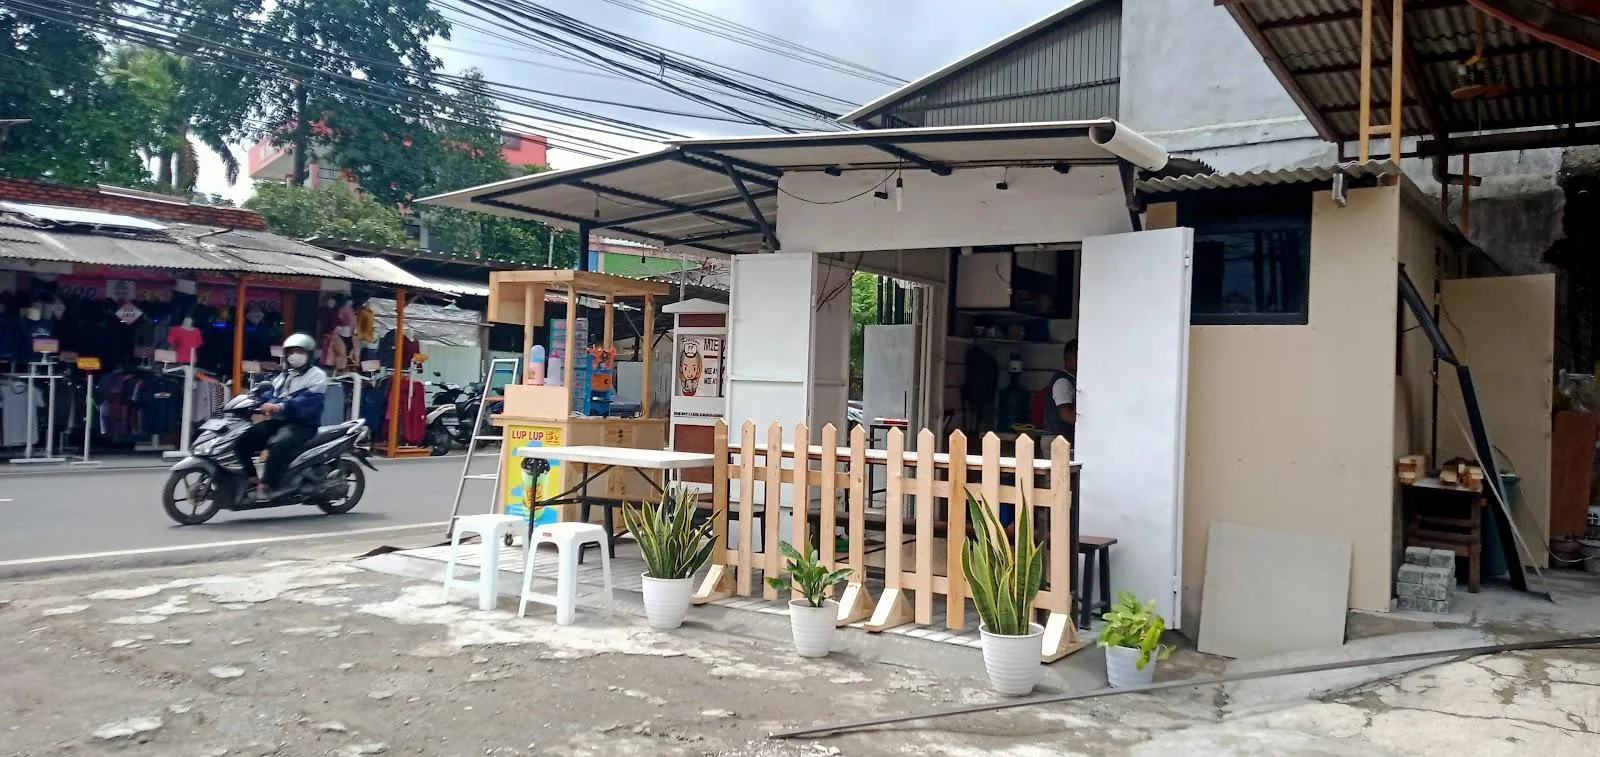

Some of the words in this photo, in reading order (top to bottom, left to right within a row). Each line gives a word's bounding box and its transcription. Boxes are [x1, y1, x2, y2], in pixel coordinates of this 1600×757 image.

[704, 338, 719, 351] MIE
[512, 430, 527, 439] LUP
[528, 431, 544, 441] LUP
